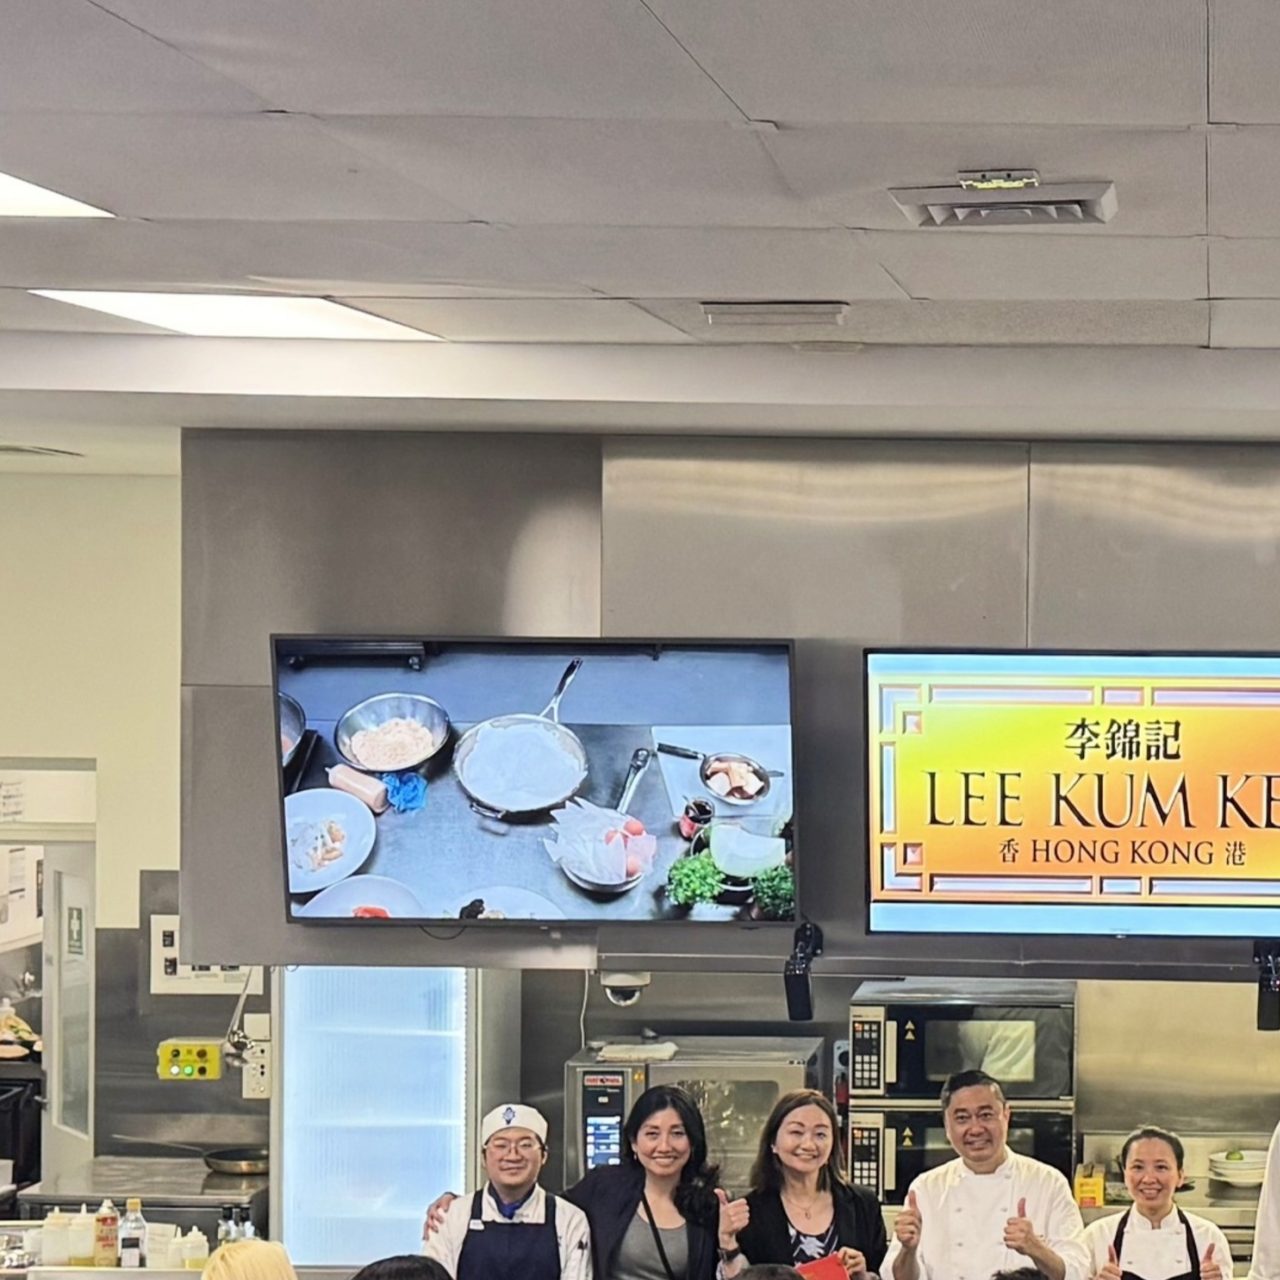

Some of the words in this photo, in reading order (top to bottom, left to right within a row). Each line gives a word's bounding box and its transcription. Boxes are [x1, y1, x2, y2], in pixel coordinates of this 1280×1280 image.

[1064, 718, 1181, 761] 李錦記
[924, 771, 1023, 827] LEE
[1051, 772, 1196, 829] KUM
[998, 840, 1020, 864] 香
[1031, 839, 1120, 865] HONG
[1130, 840, 1215, 866] KONG
[1225, 840, 1248, 867] 港
